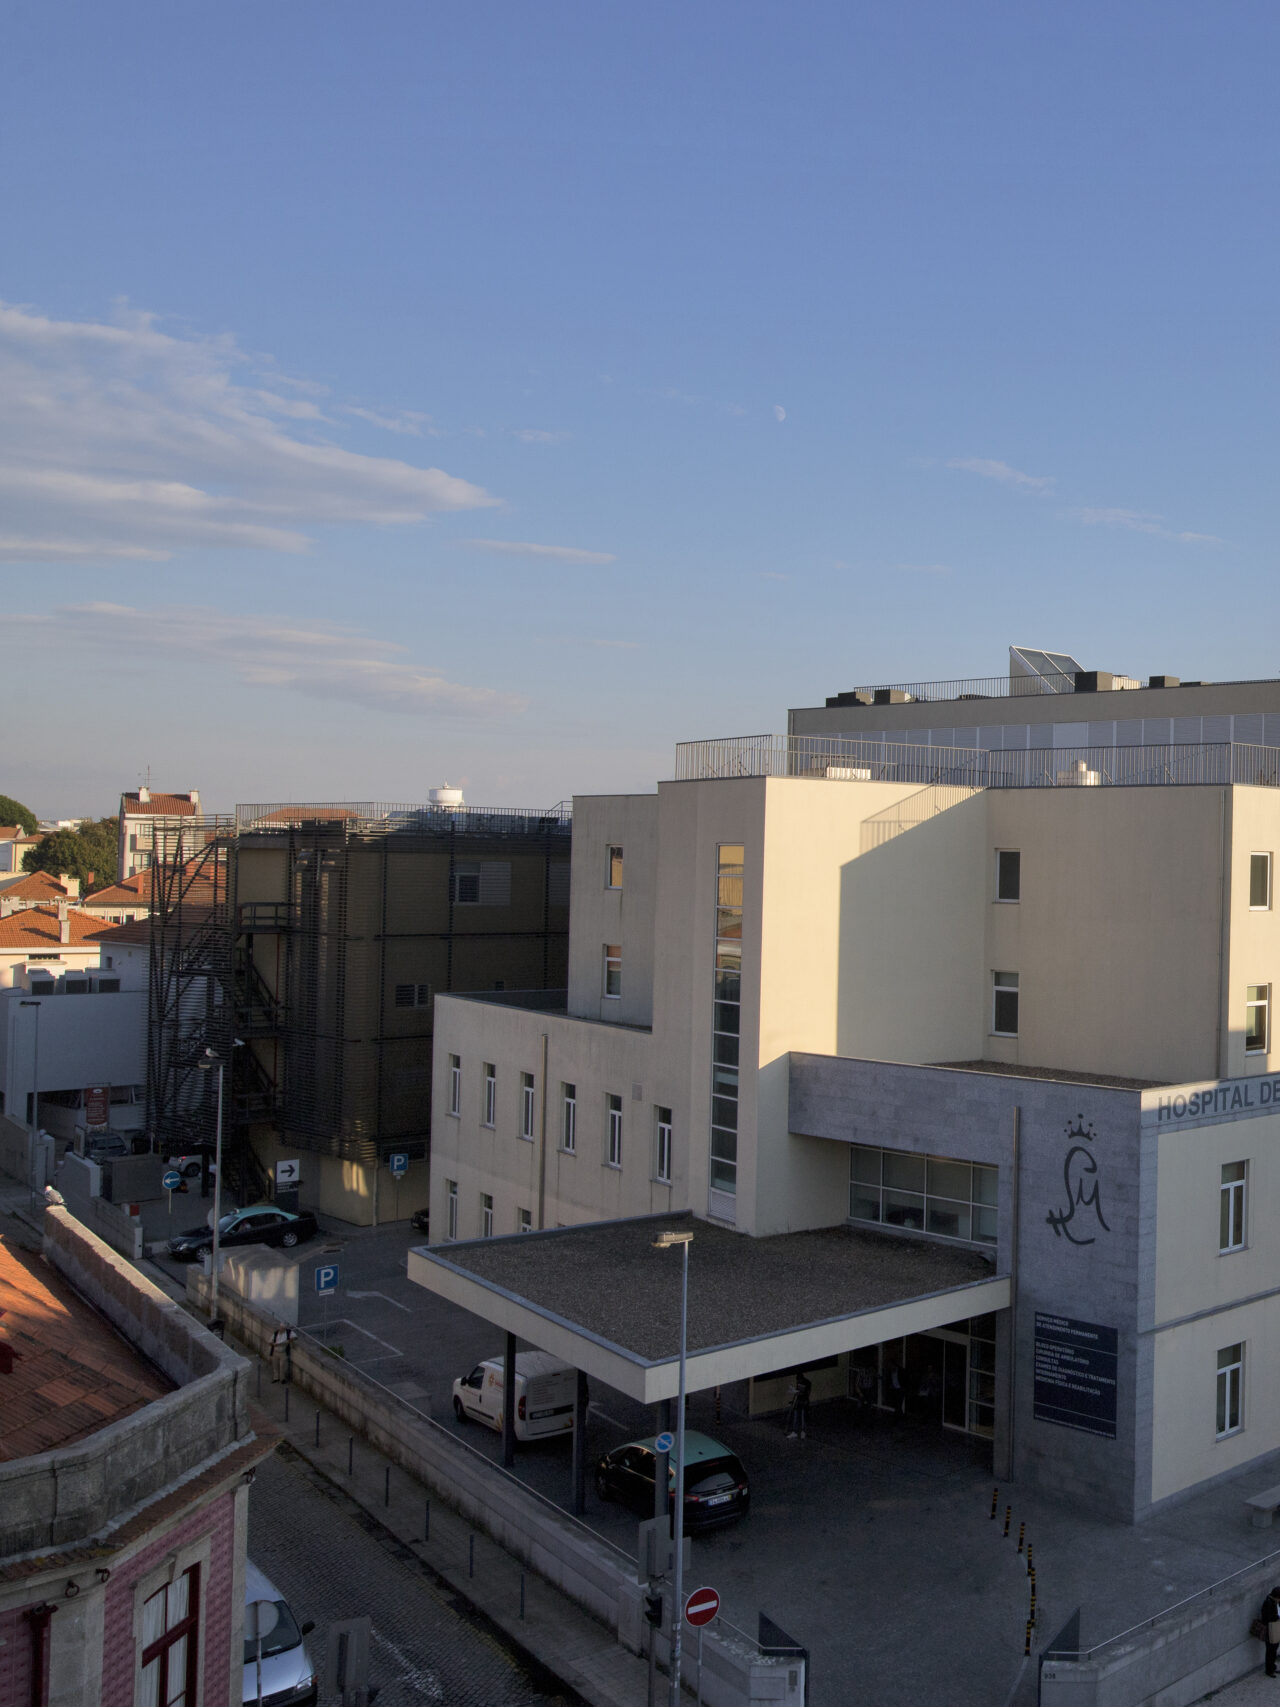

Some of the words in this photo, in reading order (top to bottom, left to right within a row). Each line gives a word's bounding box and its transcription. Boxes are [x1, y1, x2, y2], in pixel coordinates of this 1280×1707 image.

[1157, 1086, 1253, 1121] HOSPITAL
[394, 1156, 405, 1170] P
[320, 1268, 334, 1288] P
